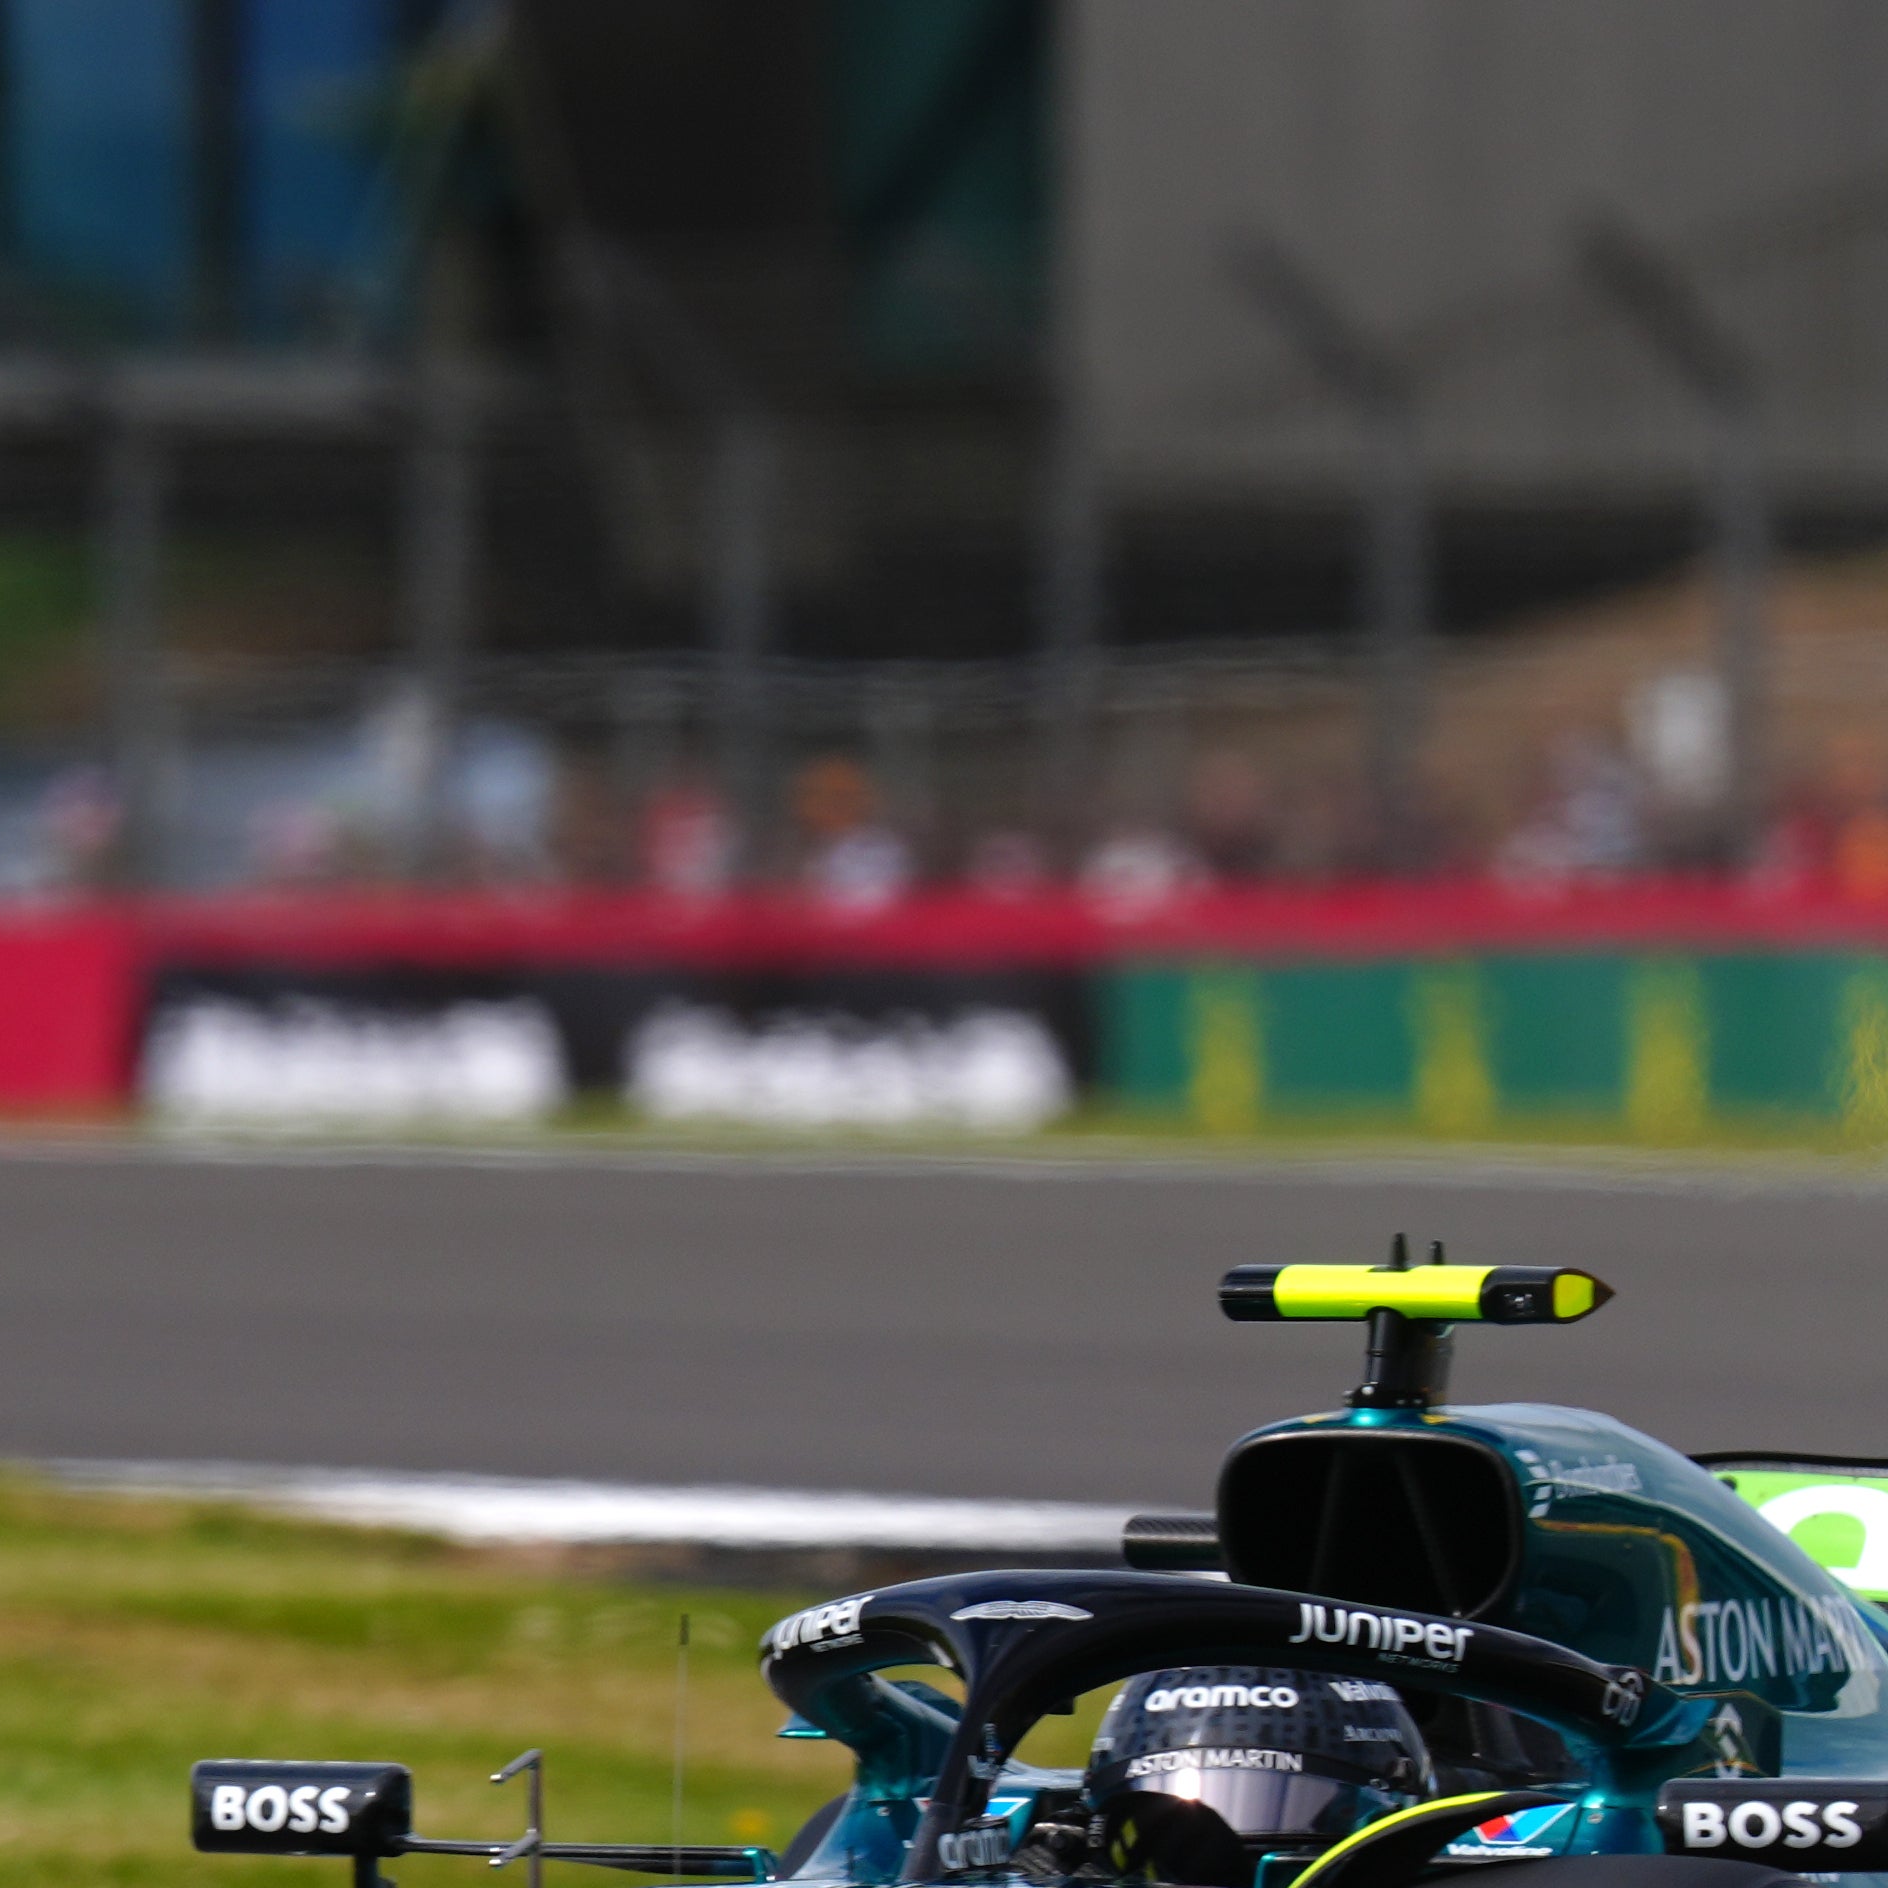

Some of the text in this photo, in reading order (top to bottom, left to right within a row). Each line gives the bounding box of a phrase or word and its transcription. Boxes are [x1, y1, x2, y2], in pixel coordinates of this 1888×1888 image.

[1653, 1600, 1778, 1686] ASTON
[1145, 1684, 1299, 1712] aramco
[1125, 1749, 1303, 1778] ASTON MARTIN
[210, 1785, 351, 1834] BOSS
[1683, 1800, 1862, 1849] BOSS
